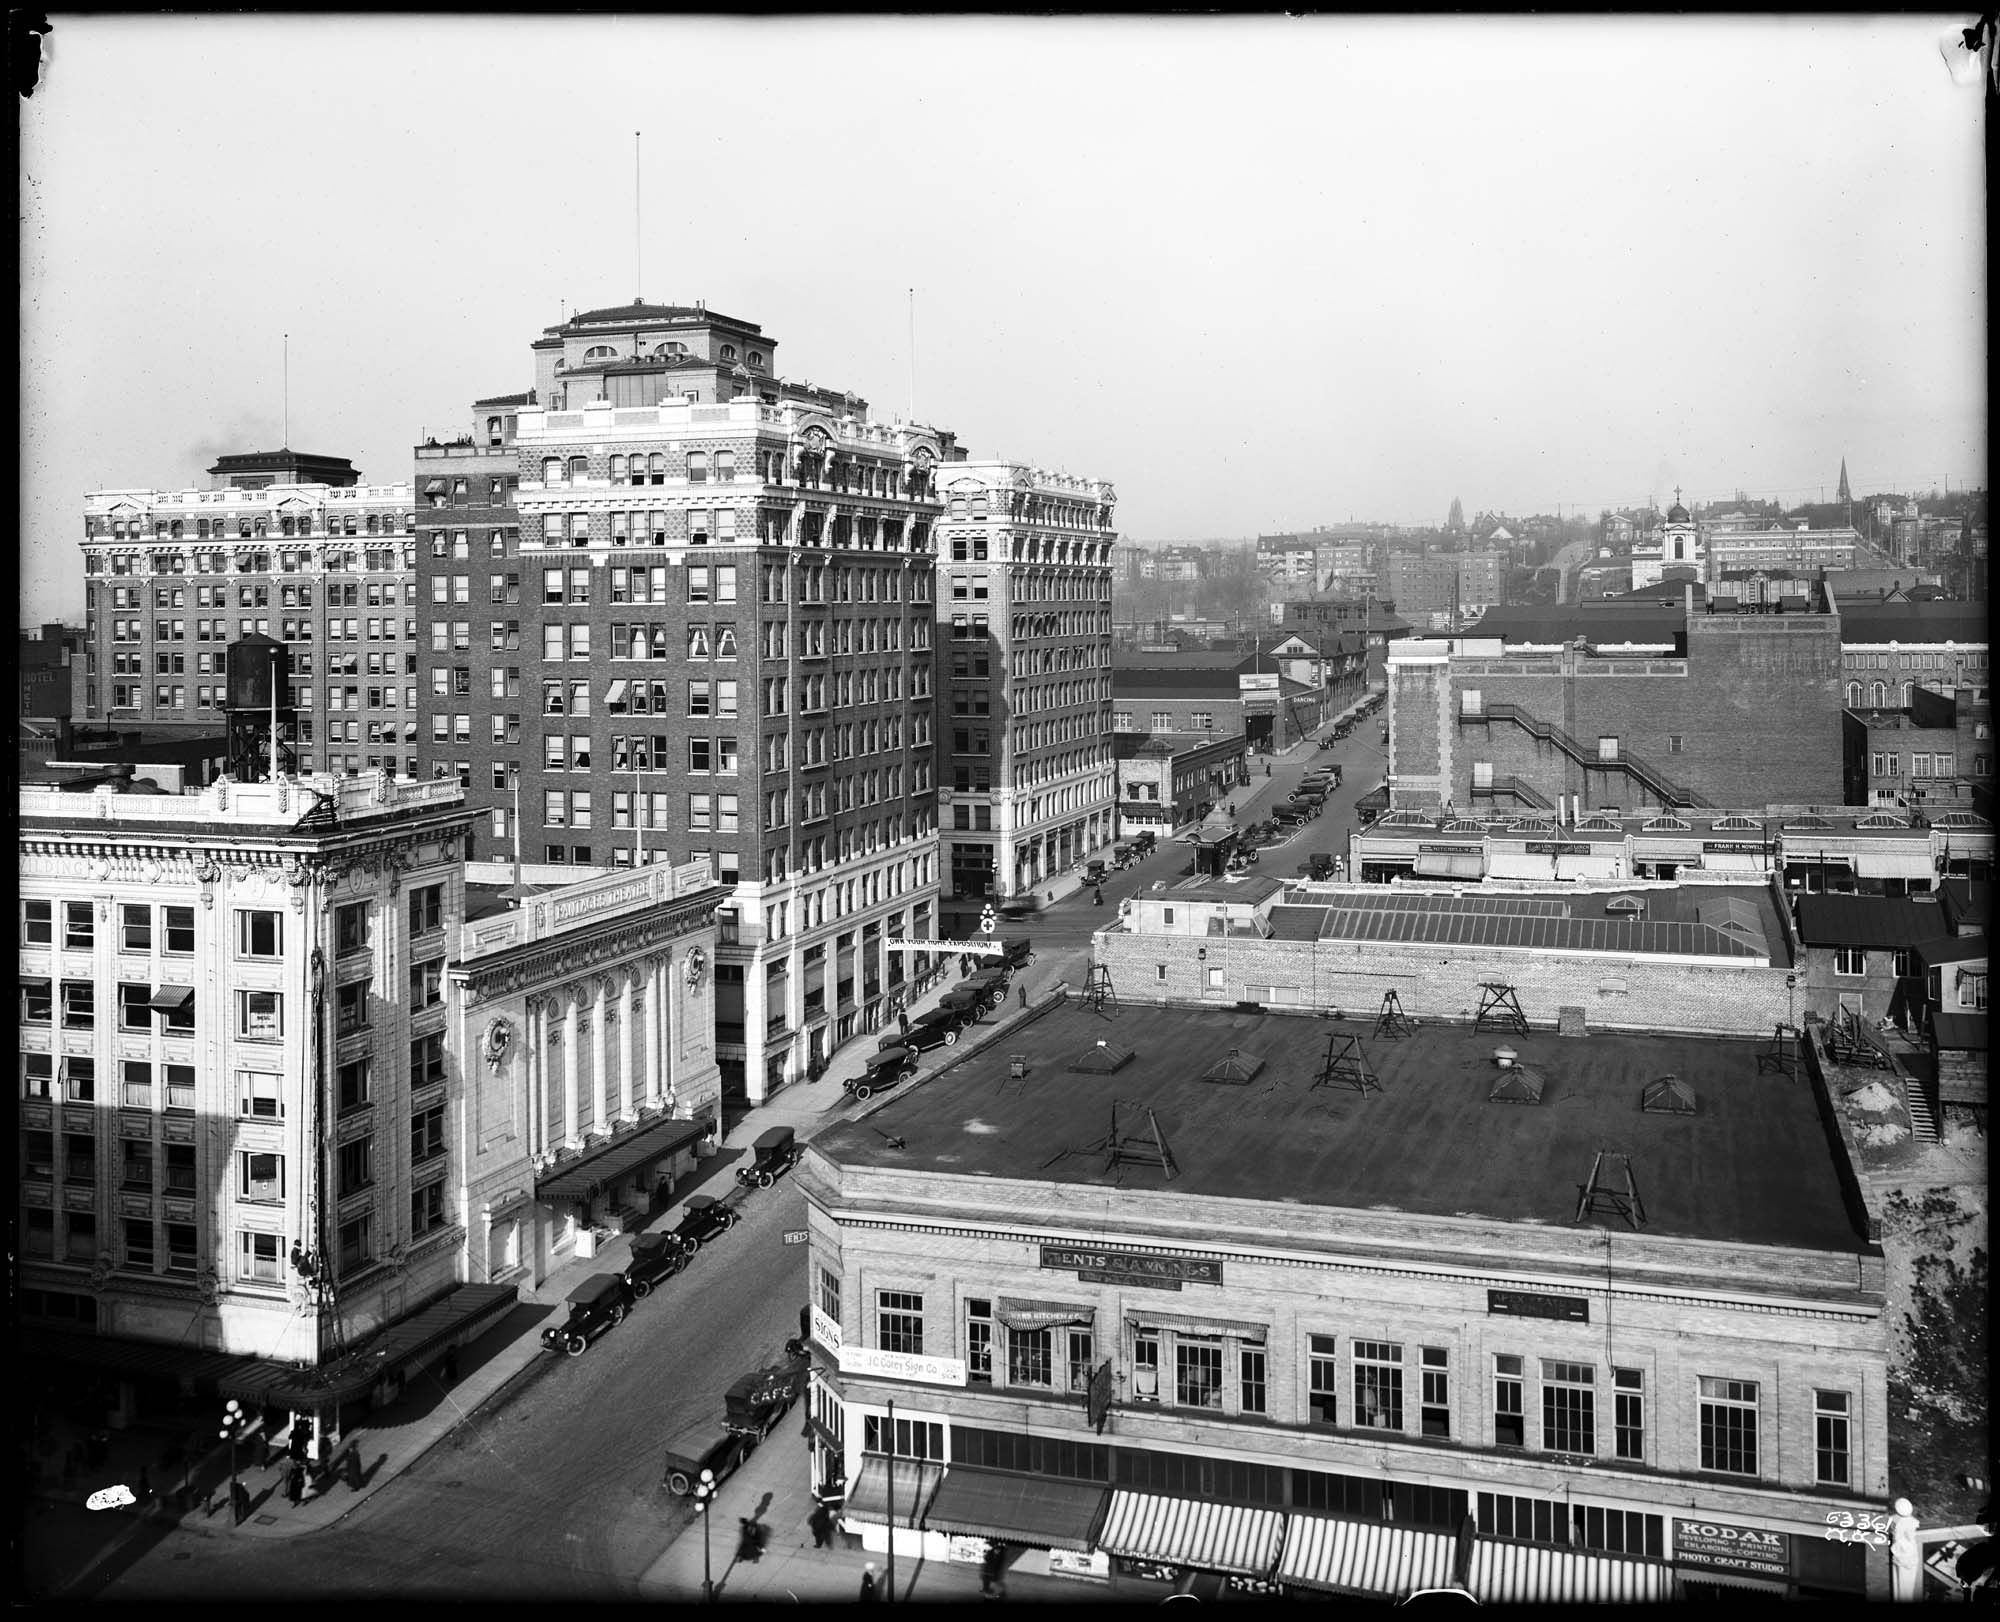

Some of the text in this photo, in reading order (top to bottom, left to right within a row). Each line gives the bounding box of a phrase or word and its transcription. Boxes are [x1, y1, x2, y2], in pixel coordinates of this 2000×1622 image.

[555, 881, 650, 922] PANTAGES THEATRE
[784, 1231, 809, 1245] TENTS
[1047, 1252, 1106, 1268] TENTS
[1130, 1258, 1211, 1278] AWNINGS
[815, 1317, 840, 1349] SIGNS
[905, 1358, 924, 1375] Sign
[750, 1385, 793, 1405] CAFE
[1678, 1533, 1785, 1555] DEVELOPING PRINTING
[1681, 1522, 1781, 1546] KODAK
[1678, 1551, 1785, 1573] PHOTO CRAFT STUDIO
